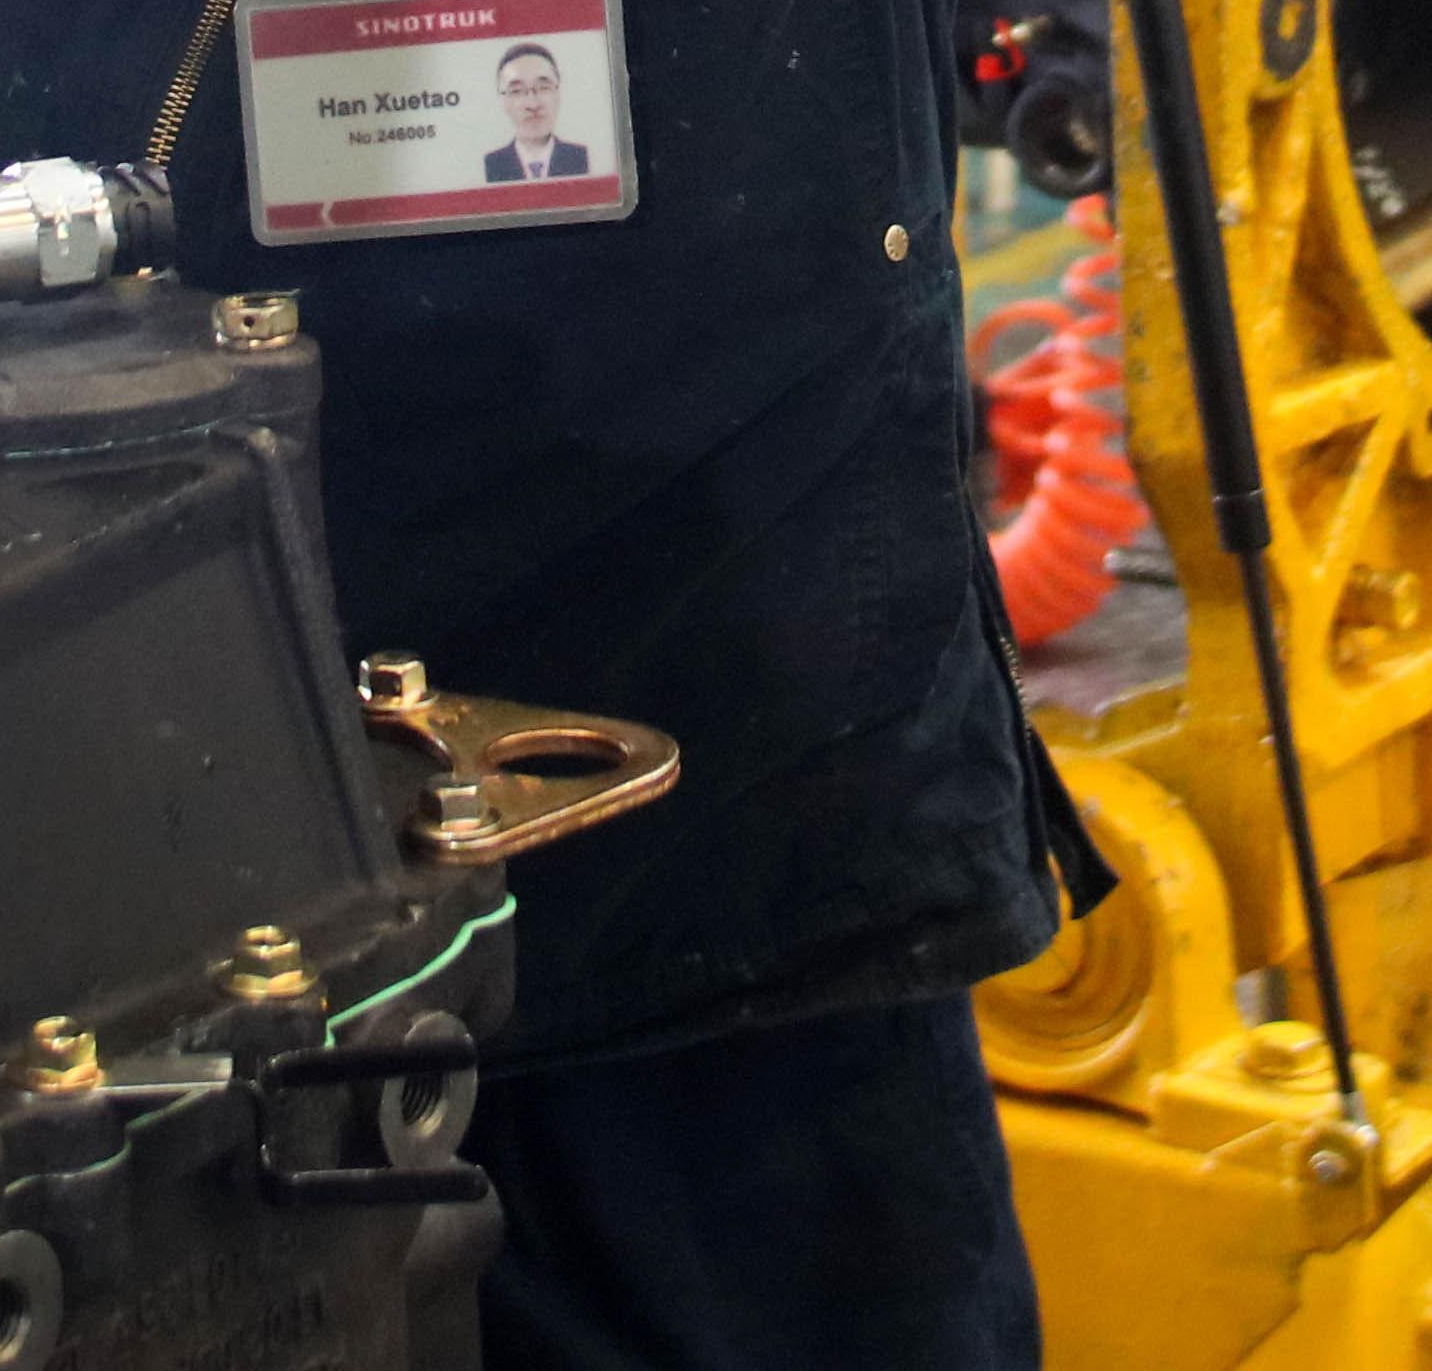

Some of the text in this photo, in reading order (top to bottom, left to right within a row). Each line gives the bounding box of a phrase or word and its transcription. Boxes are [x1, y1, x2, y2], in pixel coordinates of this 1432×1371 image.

[356, 9, 496, 36] SINOTRUK
[318, 90, 460, 118] Han Xuetao
